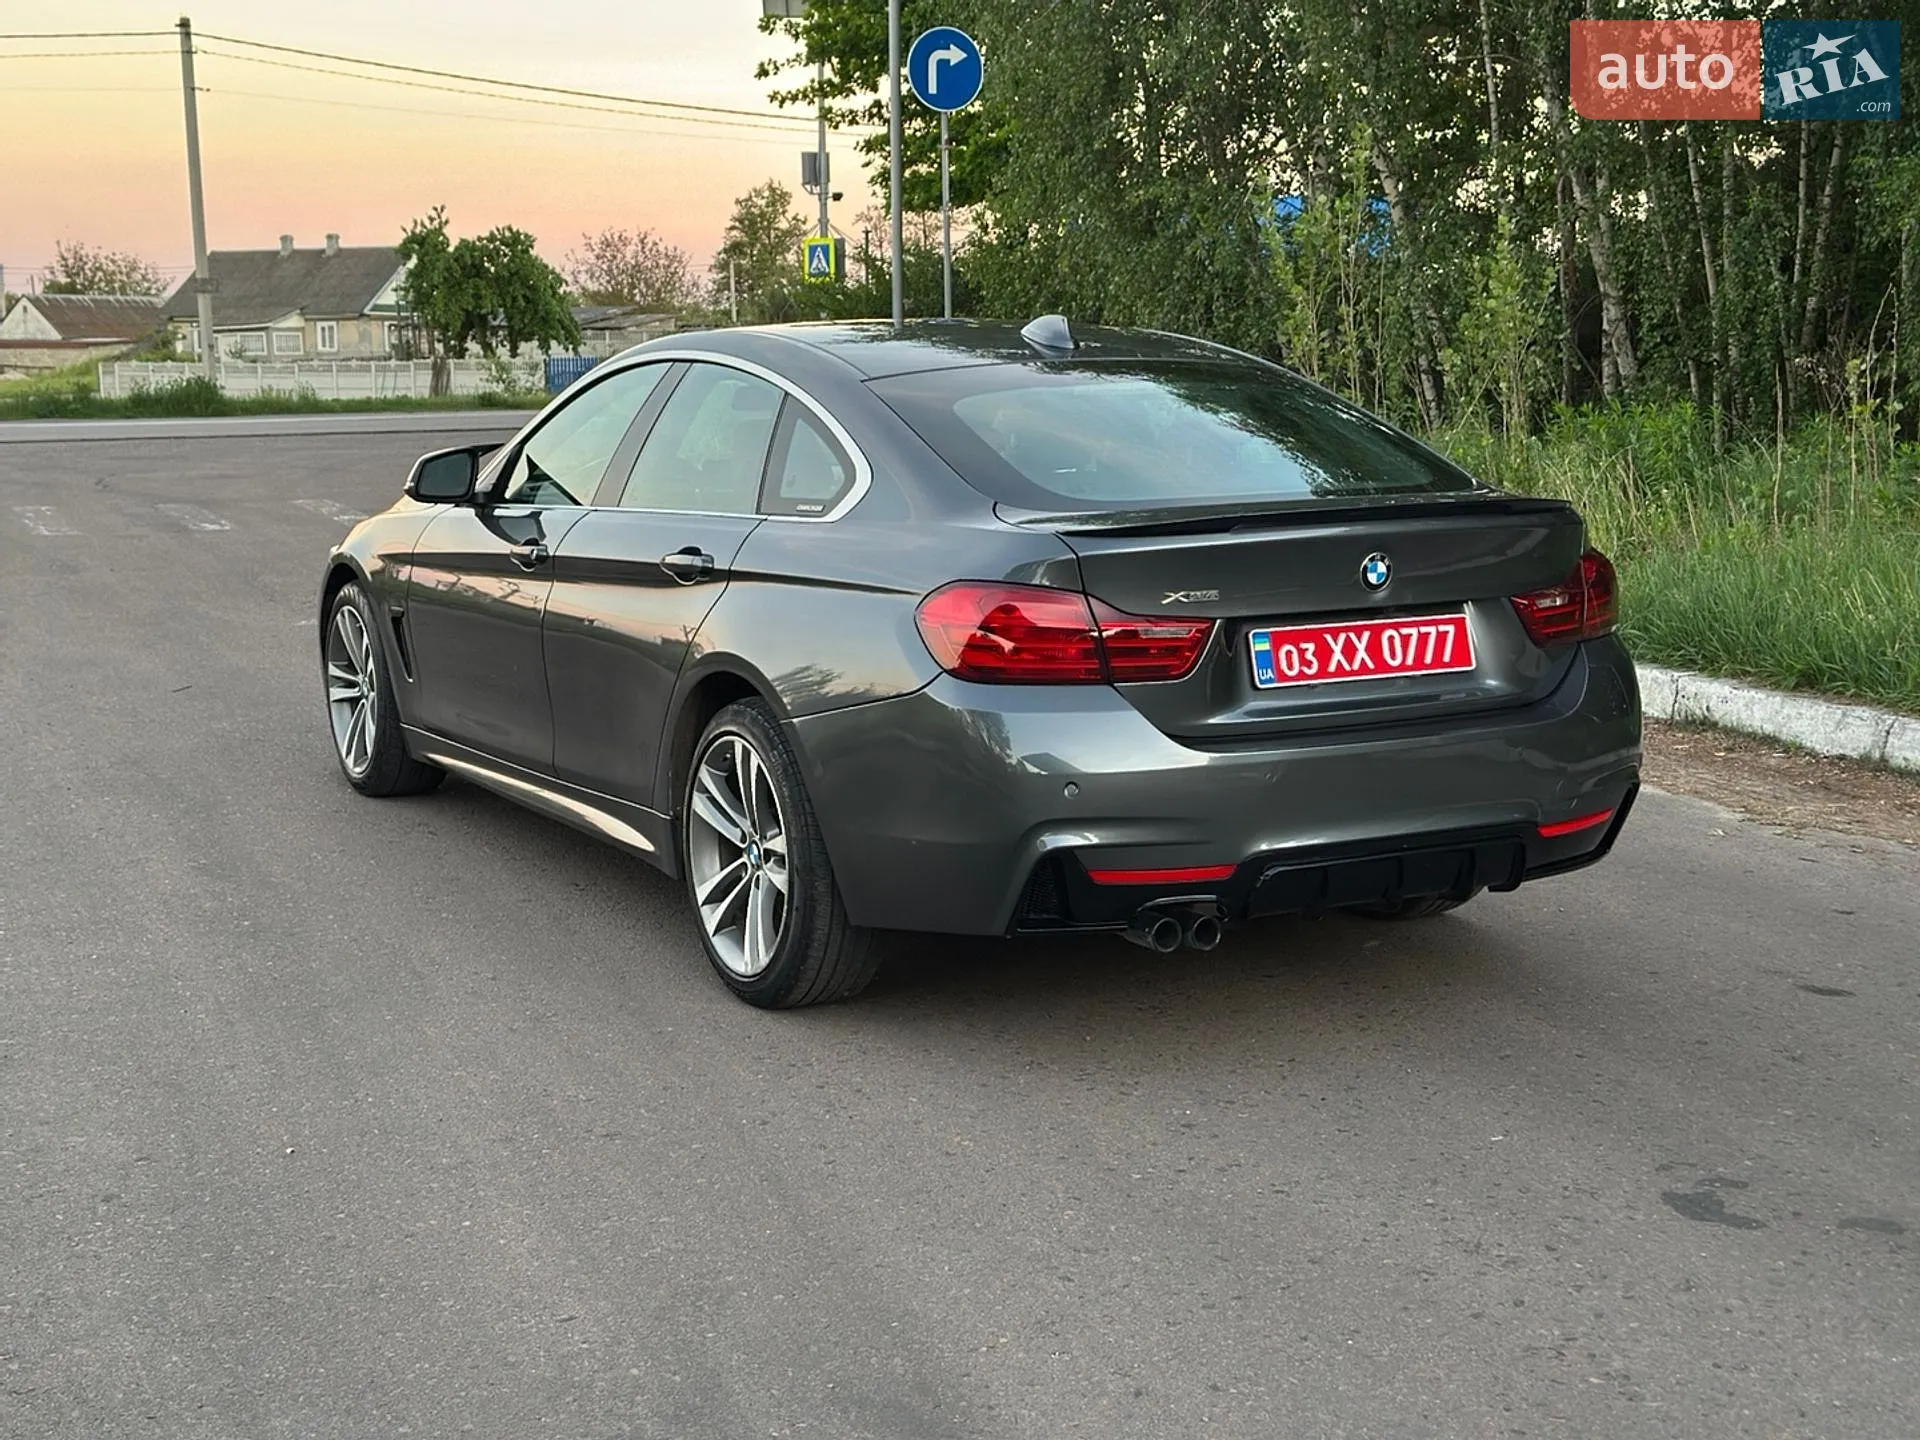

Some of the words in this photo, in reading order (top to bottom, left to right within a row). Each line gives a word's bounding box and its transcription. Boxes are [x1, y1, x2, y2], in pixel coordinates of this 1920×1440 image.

[1277, 642, 1319, 677] 03
[1323, 630, 1375, 673] XX
[1380, 624, 1456, 668] 0777
[1258, 667, 1275, 680] UA
